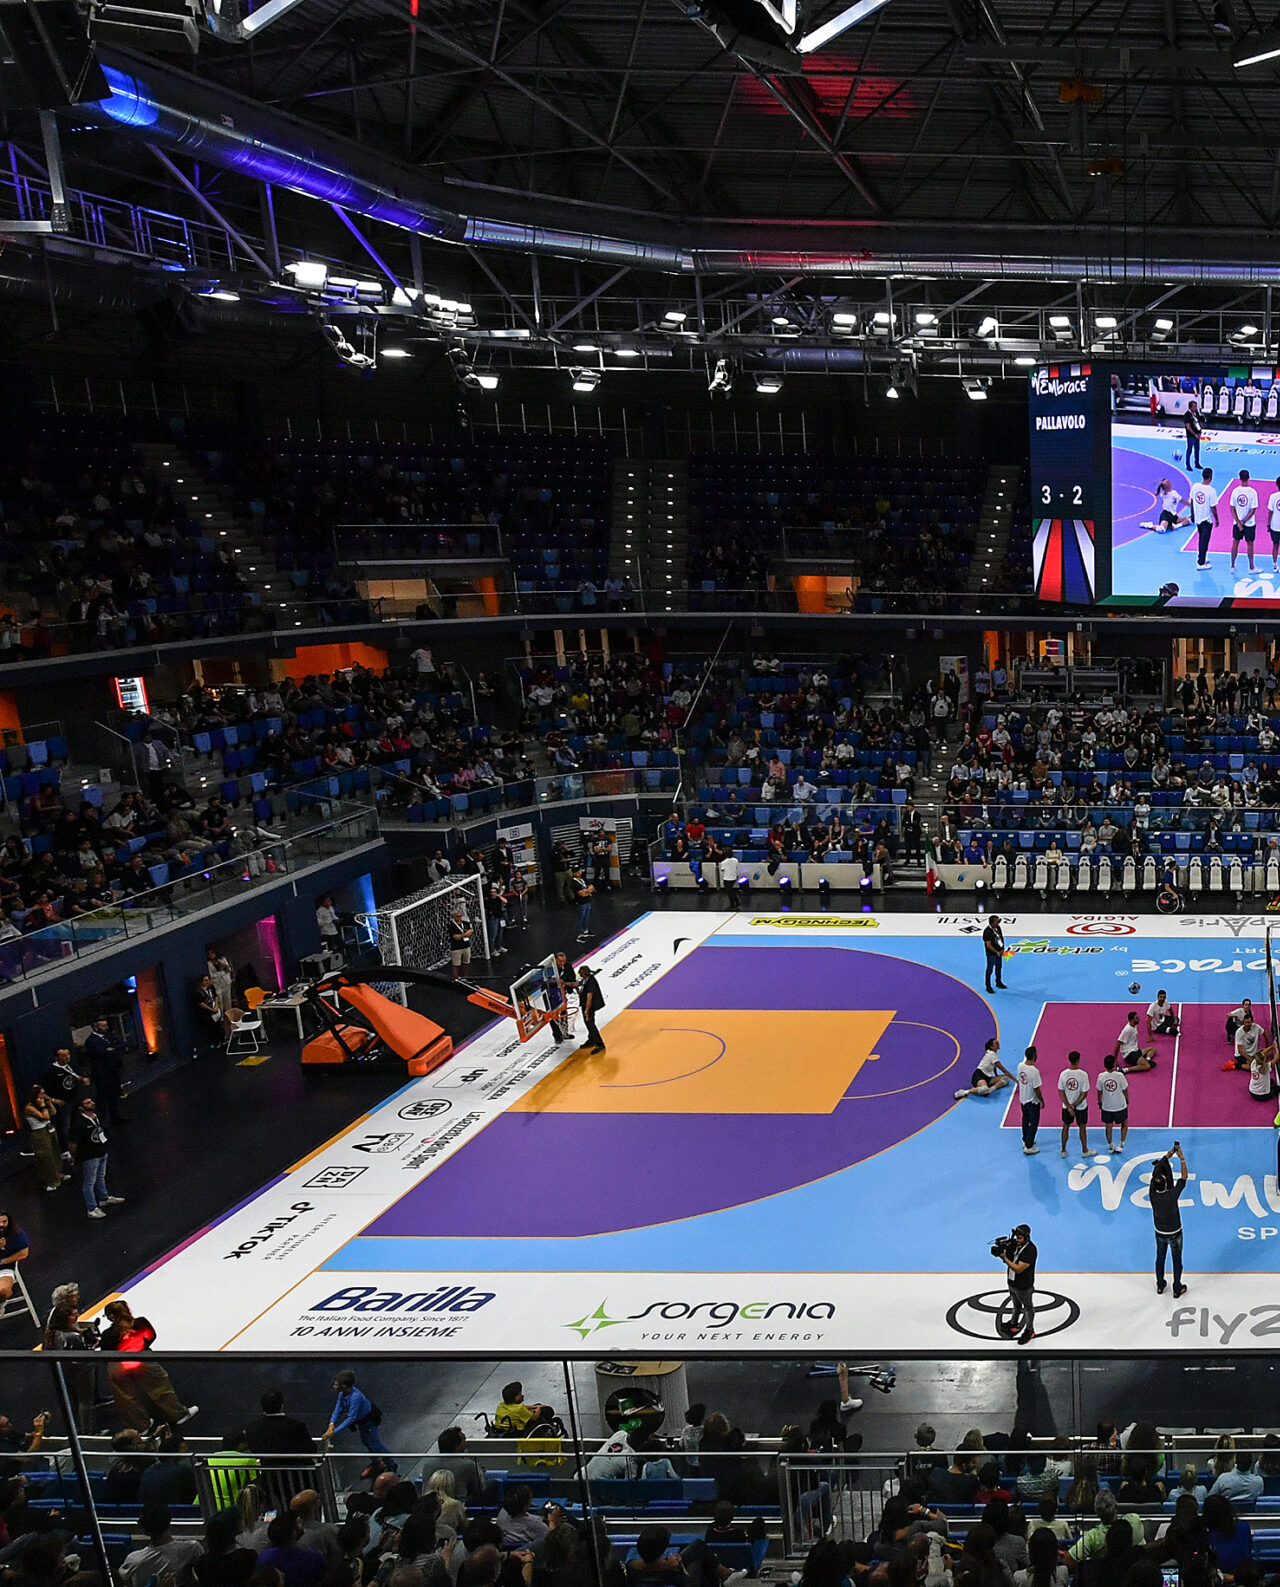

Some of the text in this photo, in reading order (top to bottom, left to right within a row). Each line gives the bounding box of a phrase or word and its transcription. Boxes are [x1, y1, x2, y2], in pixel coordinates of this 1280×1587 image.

[1036, 415, 1086, 430] PALLAVOLO
[1042, 485, 1051, 504] 3
[1072, 485, 1083, 505] 2
[589, 819, 605, 829] sky
[460, 1068, 488, 1083] up
[405, 1103, 429, 1116] JAY
[420, 1103, 447, 1116] DEE
[352, 1133, 391, 1153] TV
[223, 1215, 298, 1260] TikTok
[275, 1214, 337, 1260] ENTERTAINMENT
[262, 1234, 299, 1260] PARTNER
[308, 1286, 497, 1312] Barilla
[627, 1302, 836, 1329] sorgenia
[290, 1326, 463, 1337] 10 ANNI INSIEME
[641, 1333, 825, 1341] YOUR NEXT ENERGY
